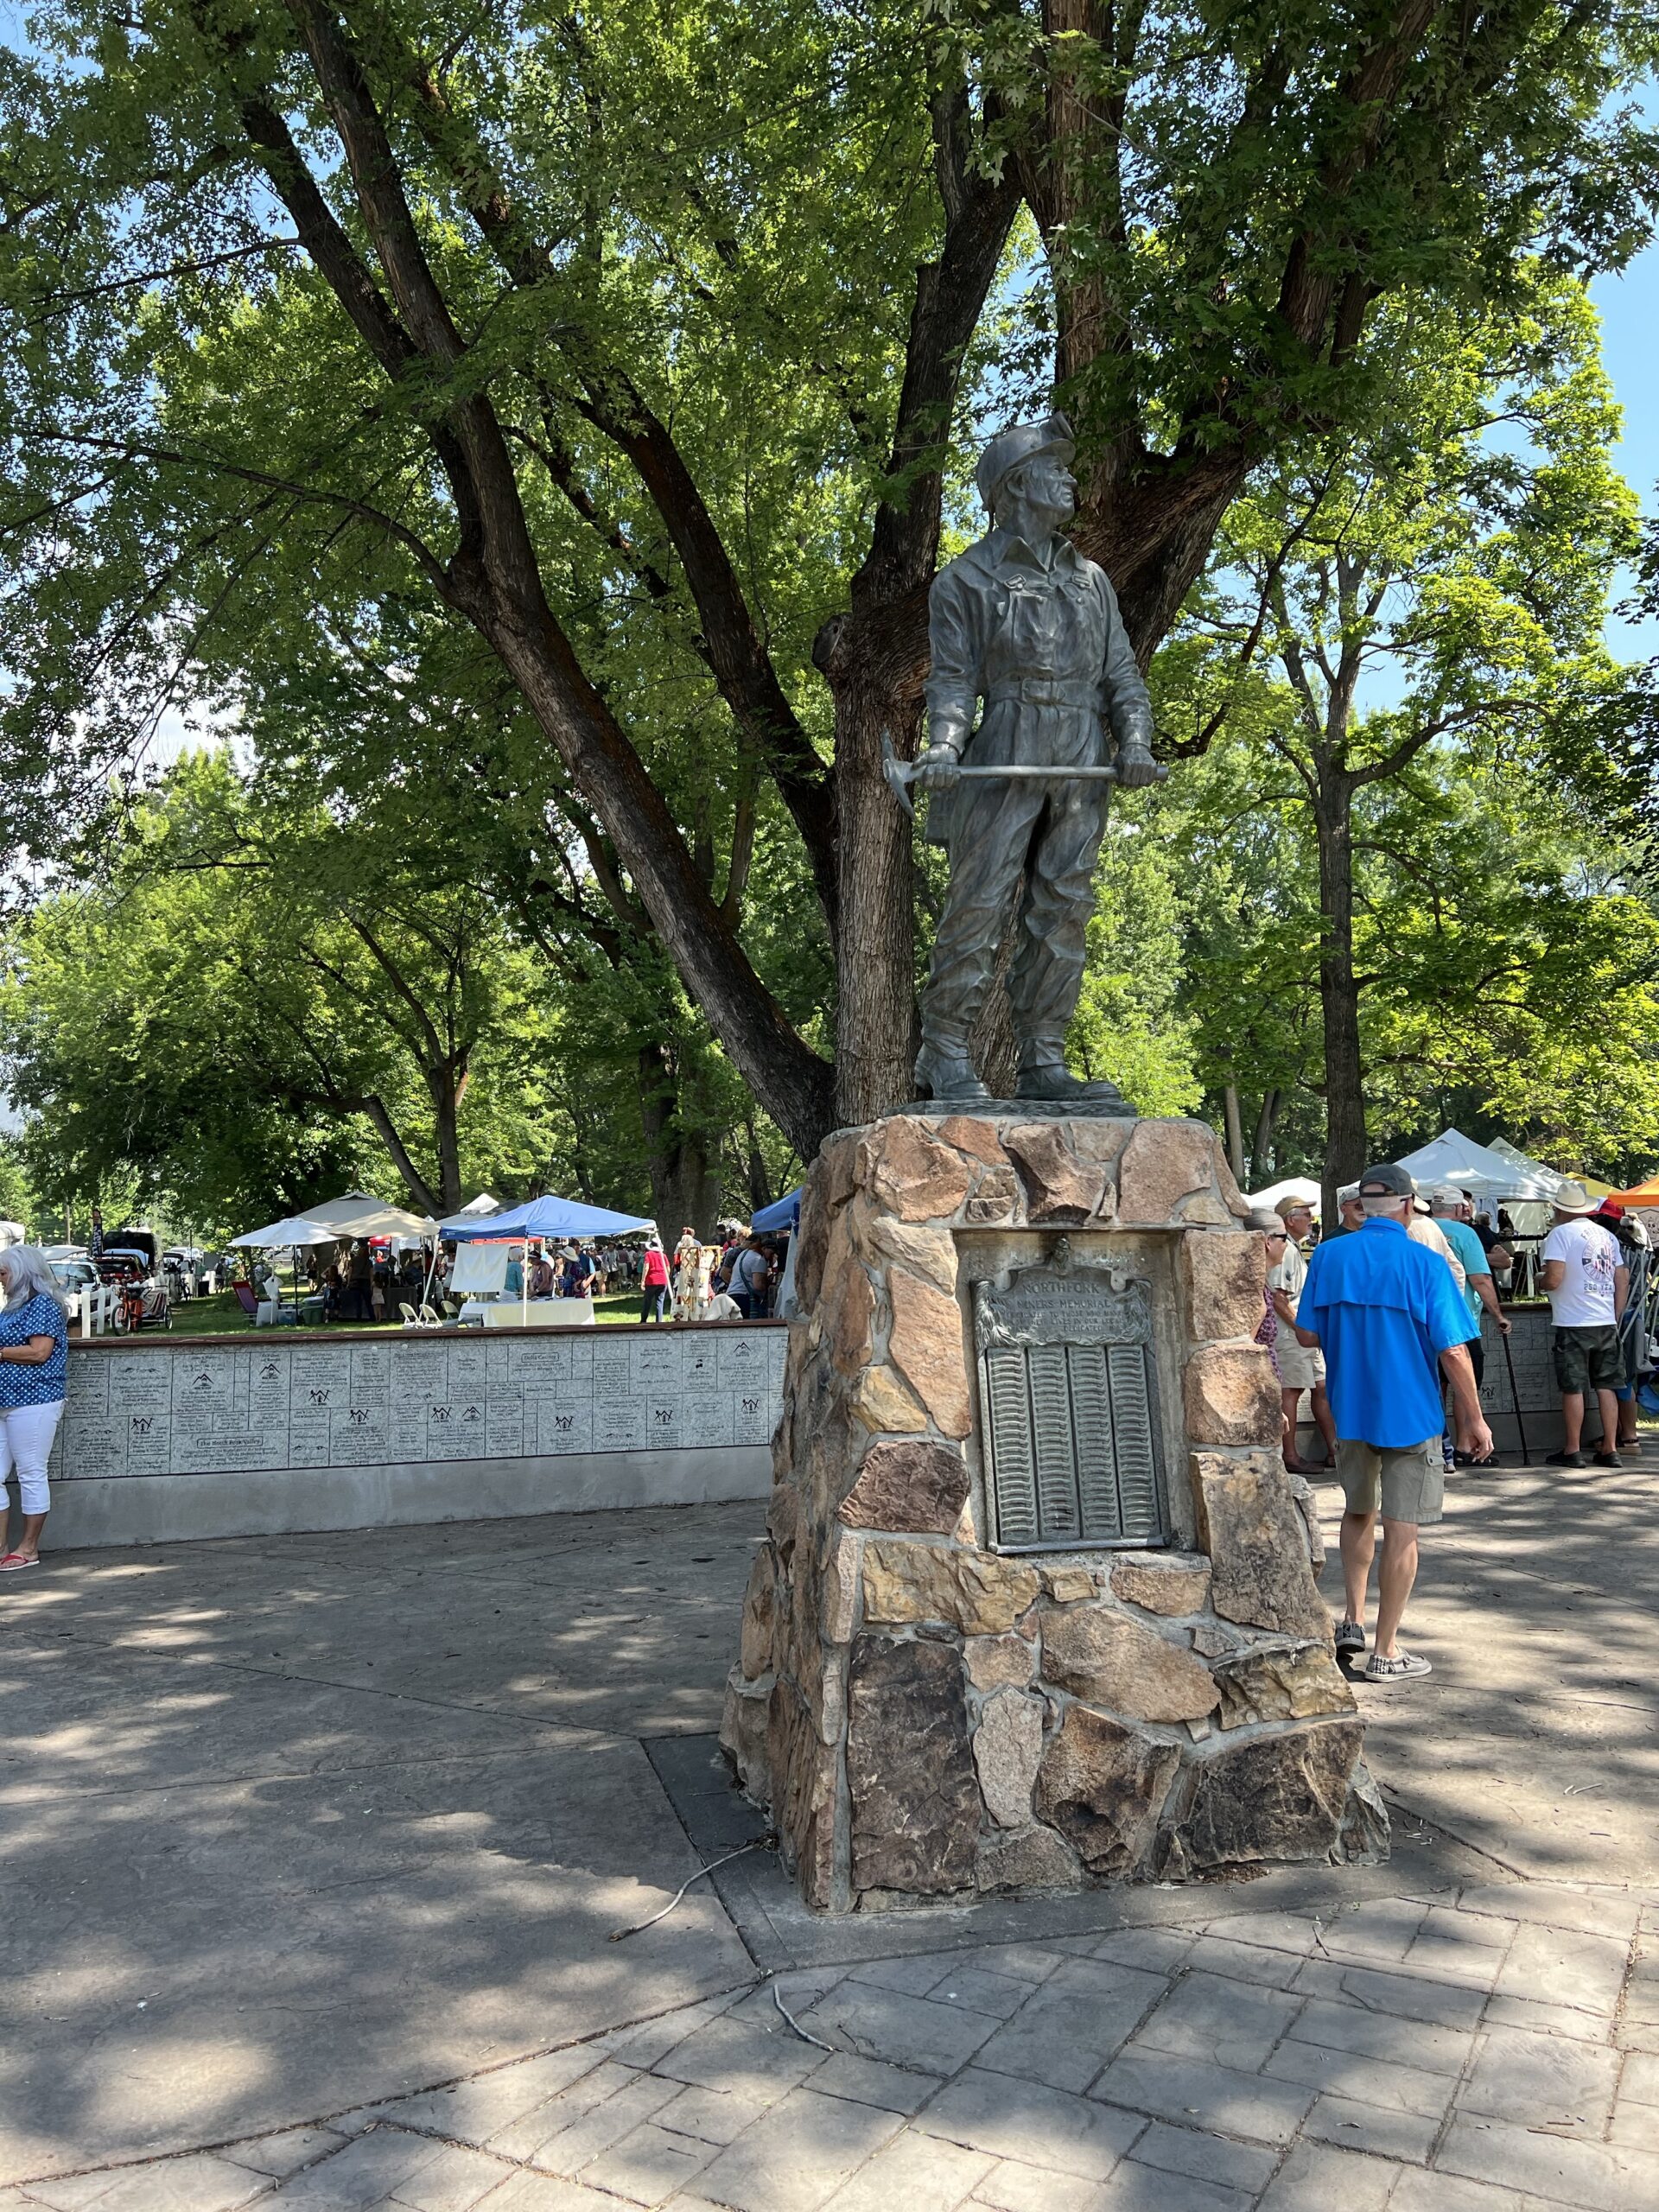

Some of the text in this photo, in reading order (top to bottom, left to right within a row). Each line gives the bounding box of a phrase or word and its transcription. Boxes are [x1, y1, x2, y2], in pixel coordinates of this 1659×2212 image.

[1022, 1281, 1101, 1294] NORTHFORK
[1017, 1299, 1111, 1309] MINERS MEMORIAL
